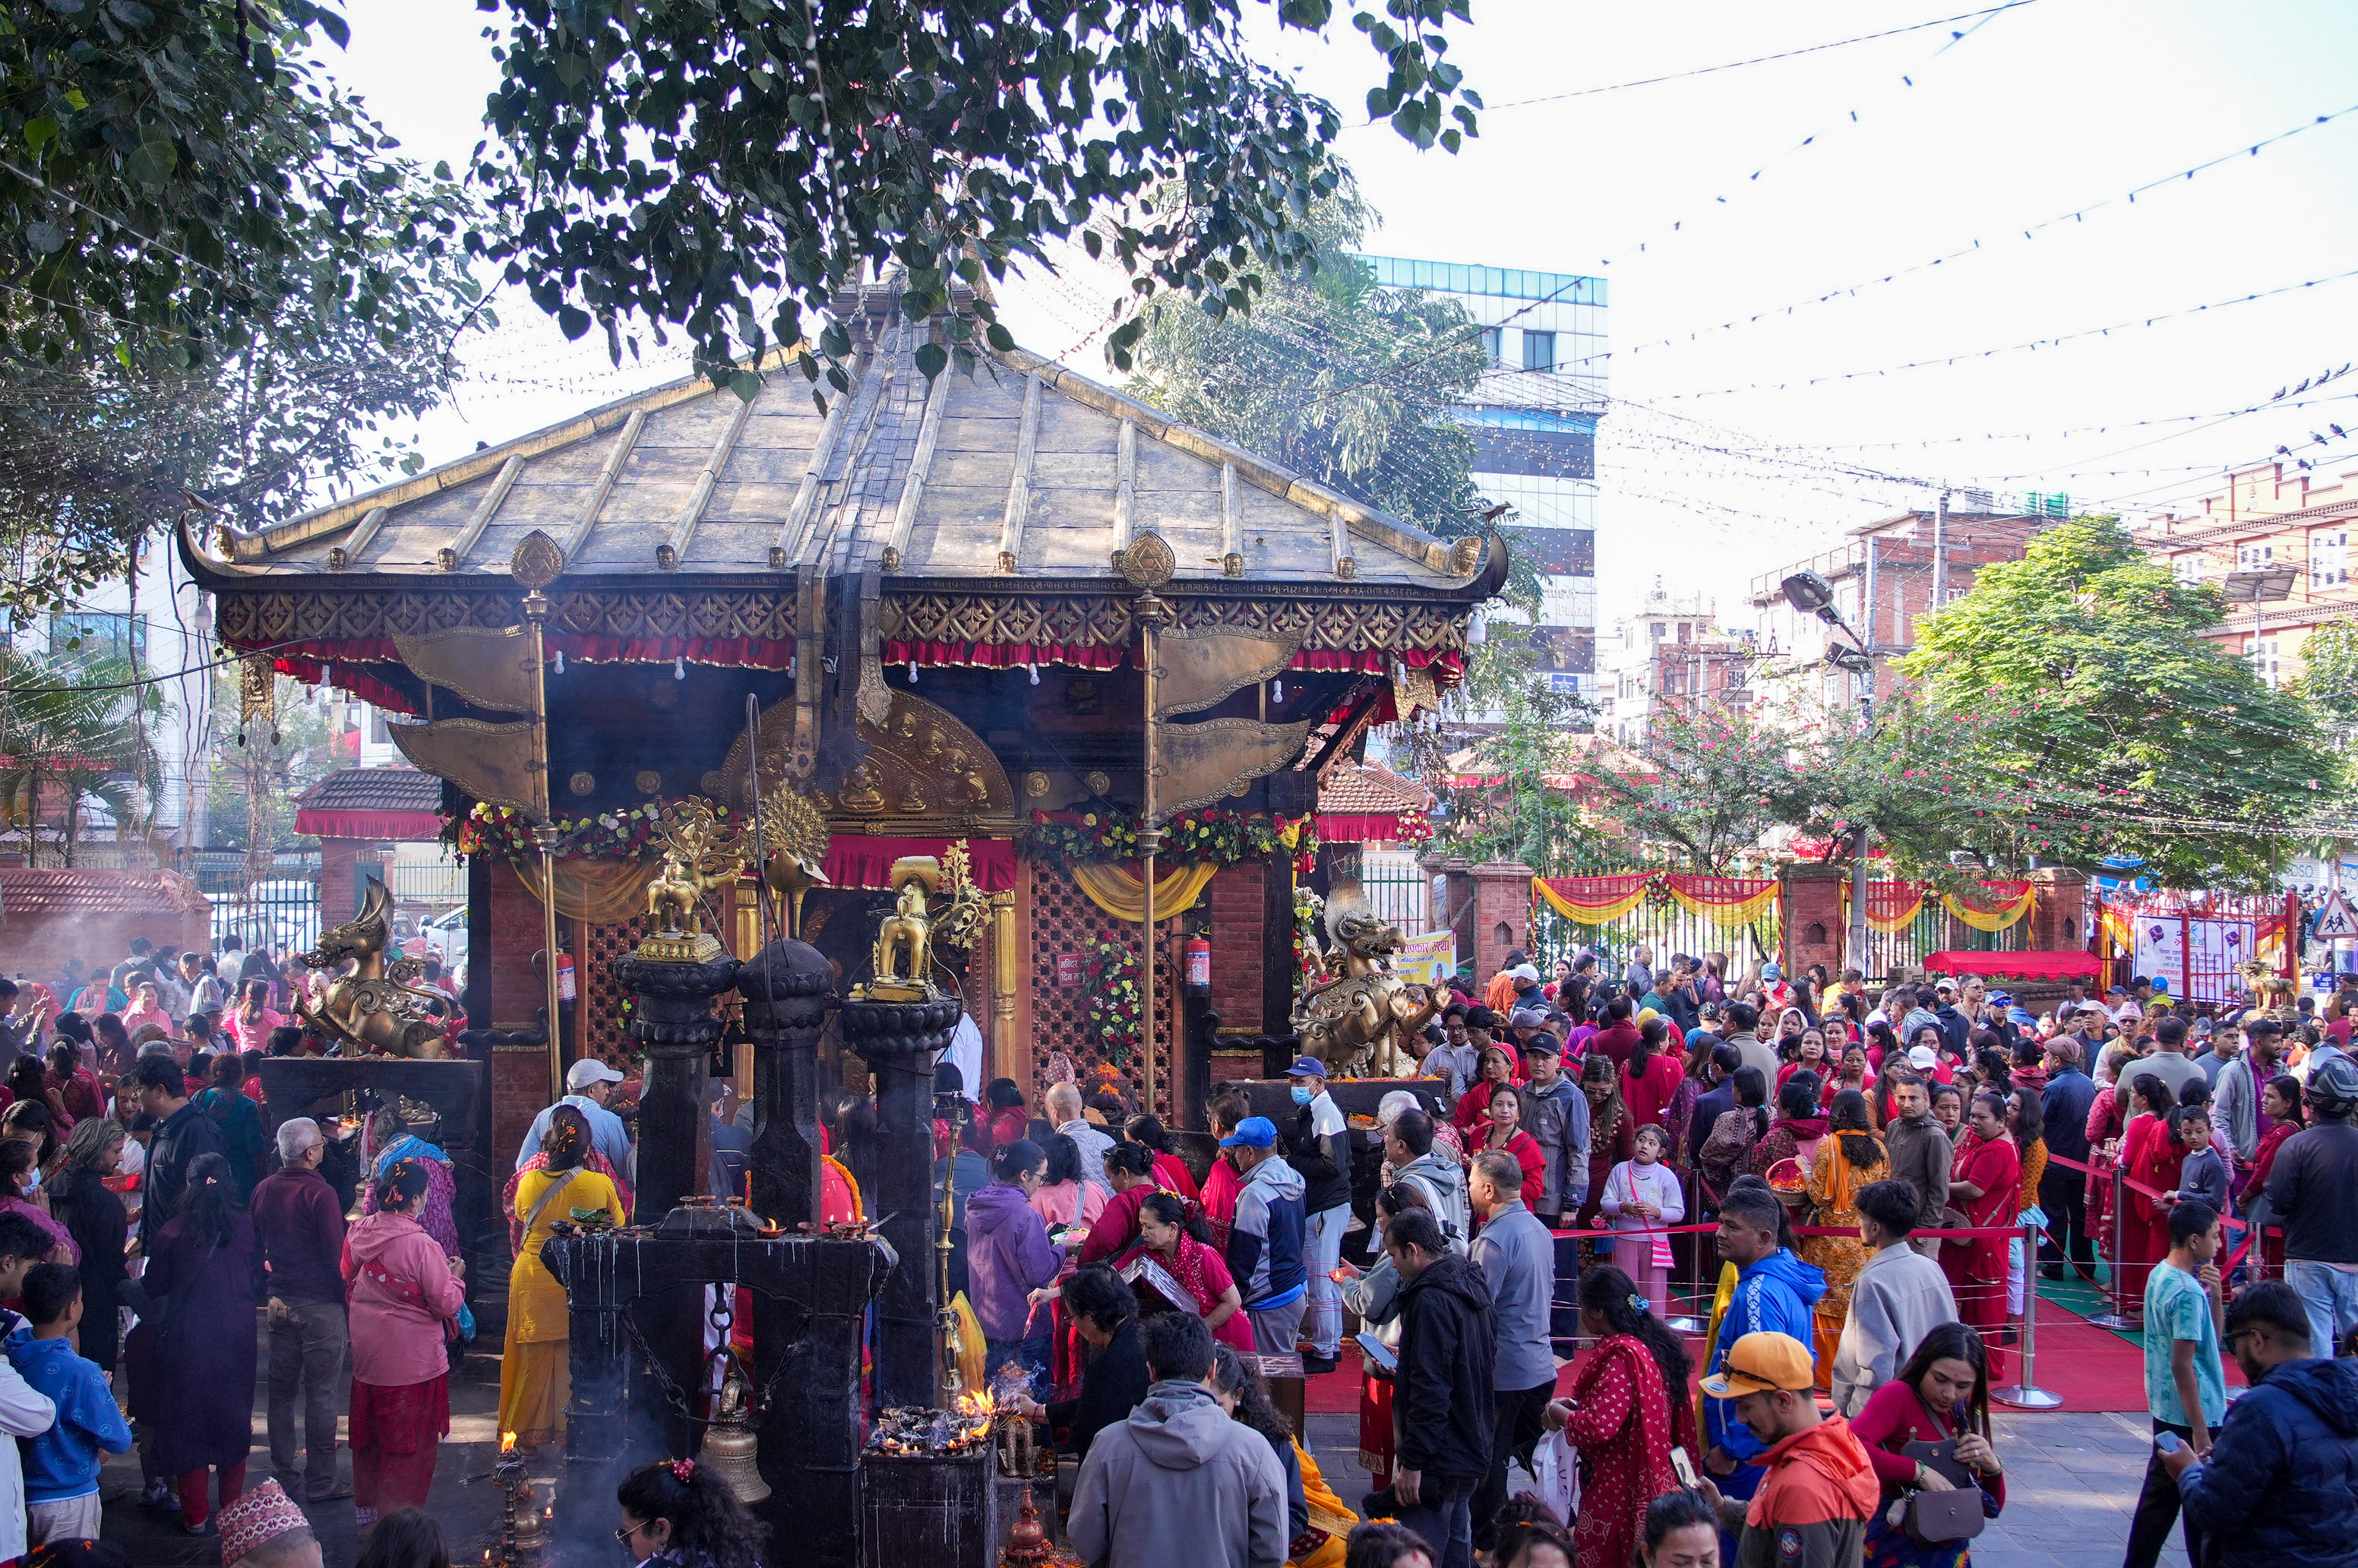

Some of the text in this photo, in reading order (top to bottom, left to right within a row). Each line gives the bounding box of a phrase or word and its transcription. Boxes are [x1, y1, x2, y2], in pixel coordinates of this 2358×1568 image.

[1558, 604, 1591, 617] PLAZA
[1432, 939, 1450, 953] संस्था
[1060, 959, 1079, 969] मन्दिर
[1061, 972, 1073, 982] दिन
